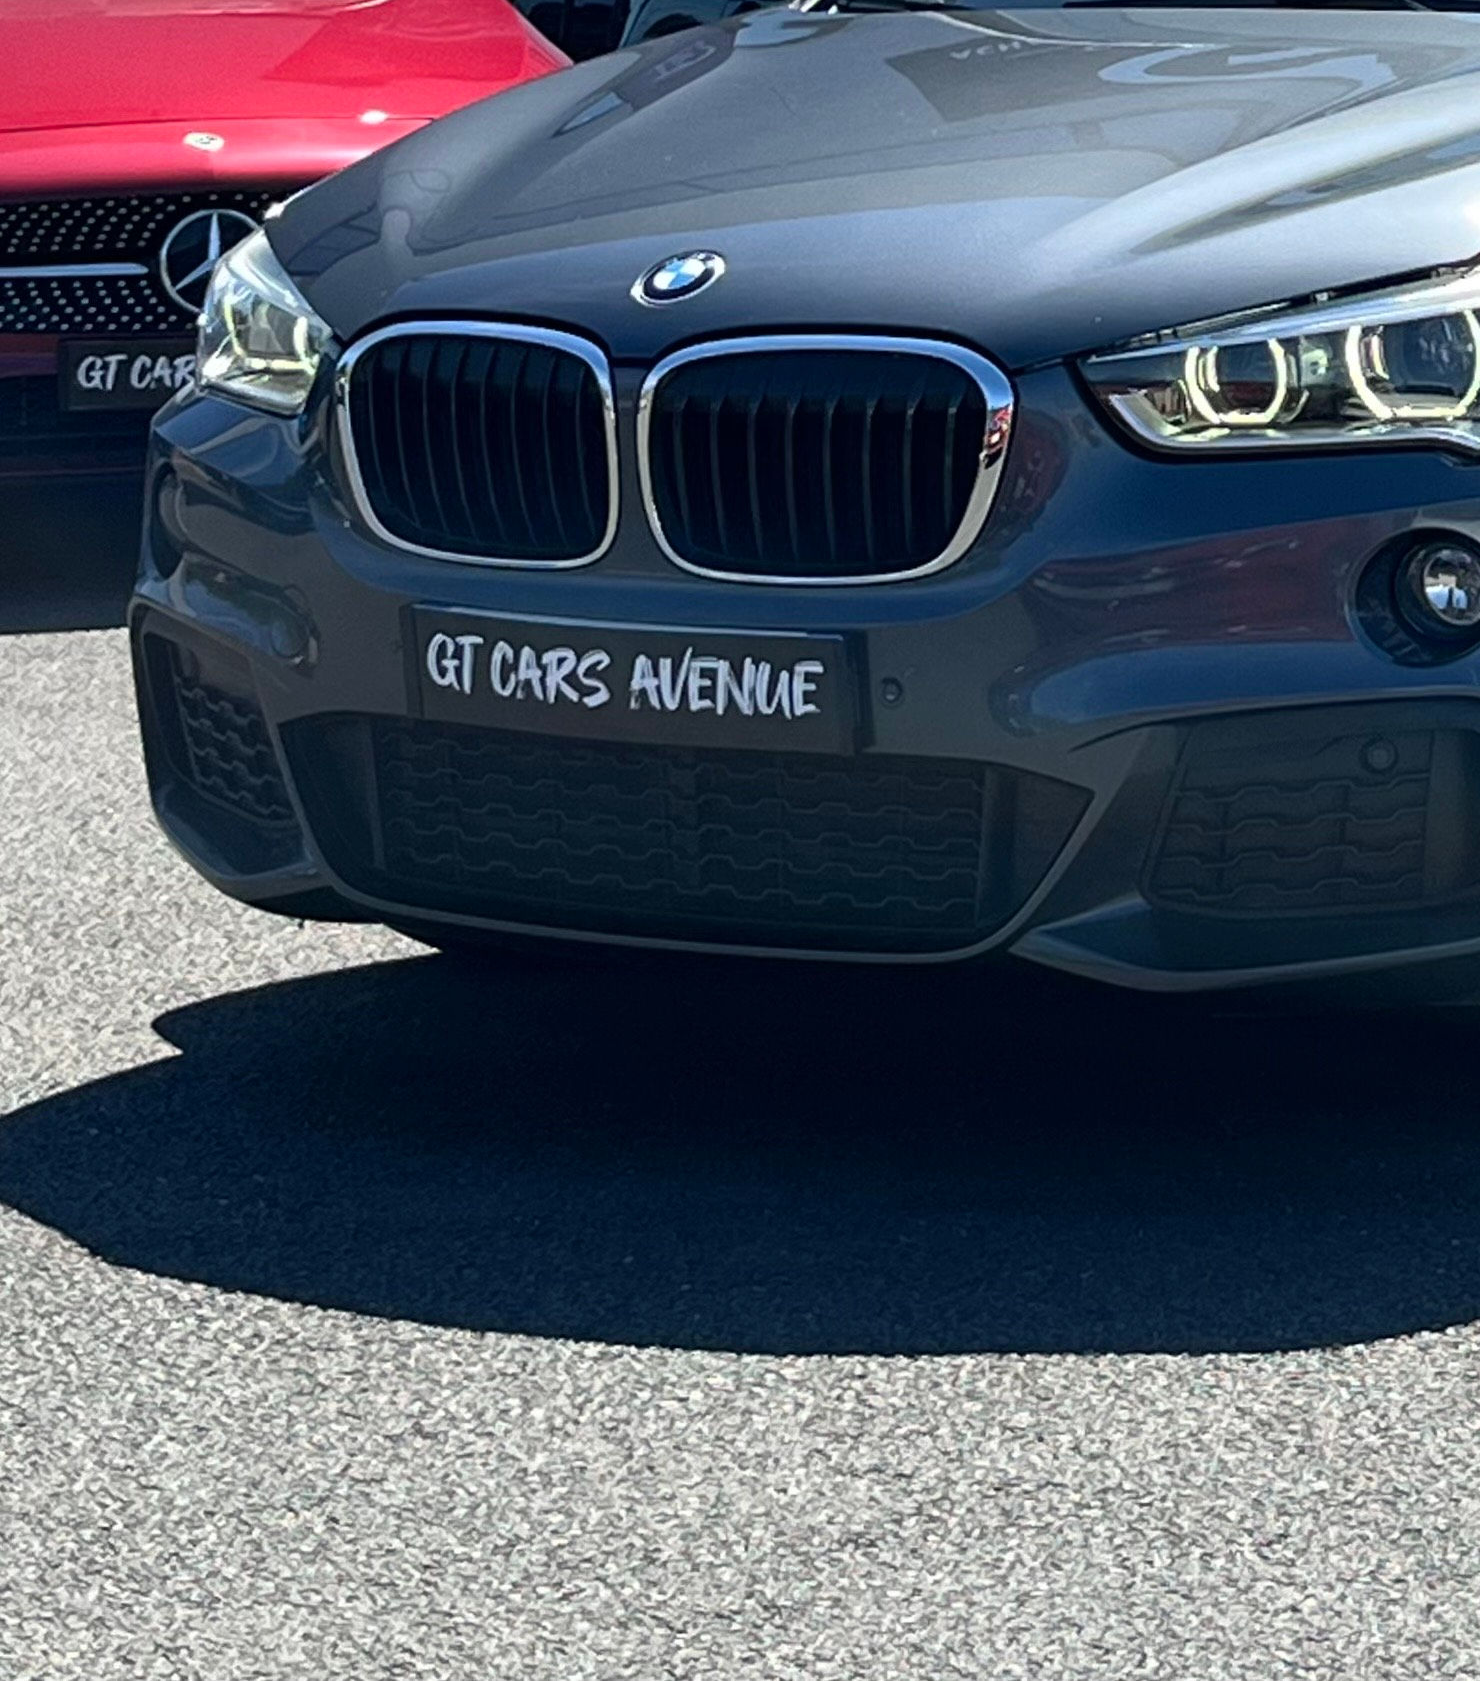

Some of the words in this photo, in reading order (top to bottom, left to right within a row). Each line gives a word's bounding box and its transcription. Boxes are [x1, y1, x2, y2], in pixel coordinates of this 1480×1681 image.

[77, 354, 128, 390] GT
[426, 632, 484, 695] GT
[490, 640, 611, 708] CARS
[629, 646, 825, 720] AVENUE
